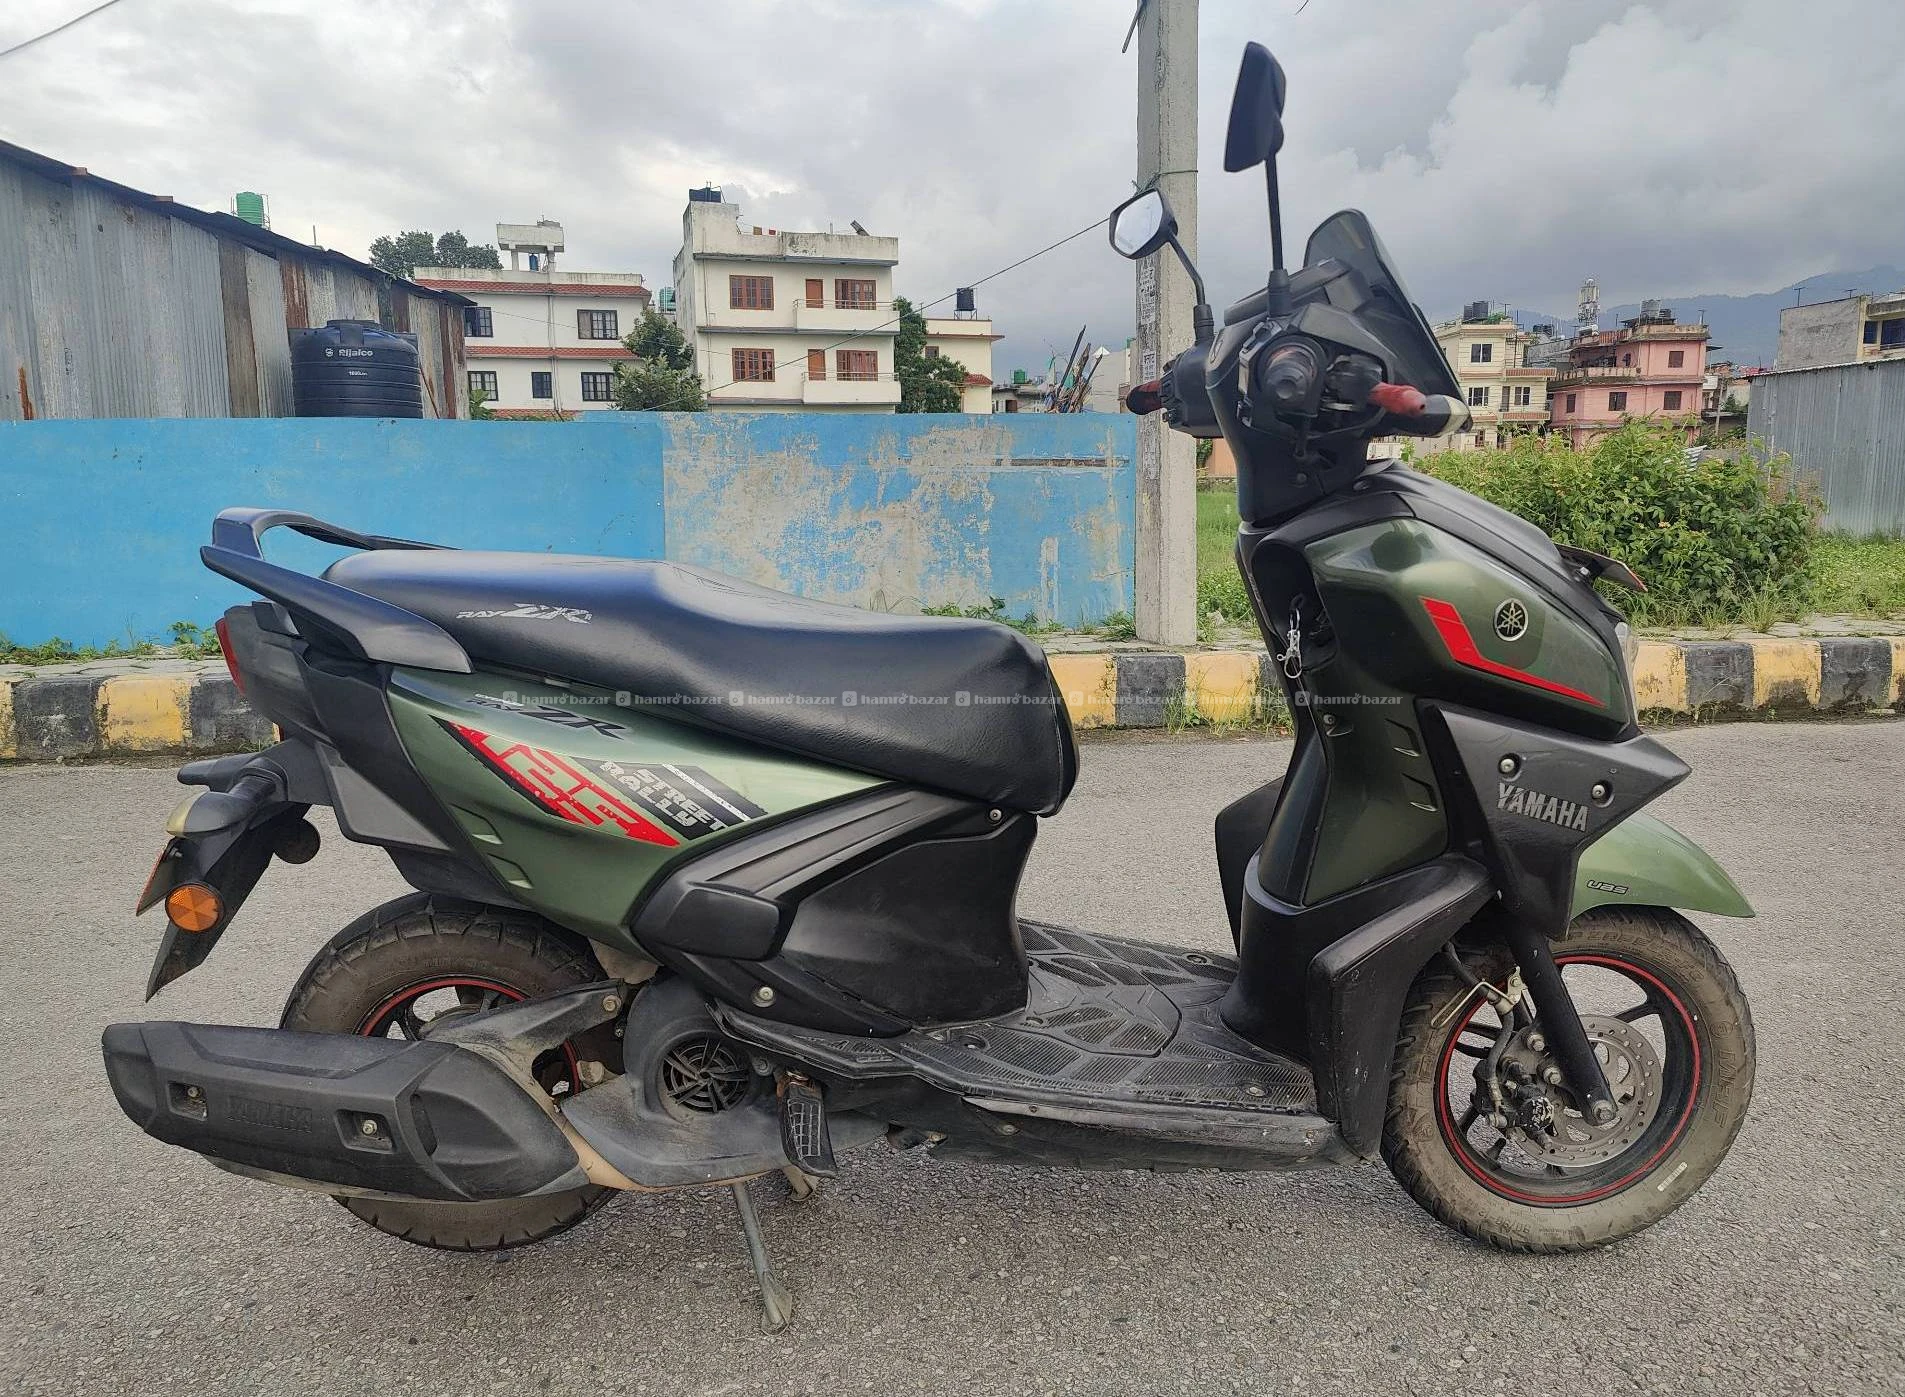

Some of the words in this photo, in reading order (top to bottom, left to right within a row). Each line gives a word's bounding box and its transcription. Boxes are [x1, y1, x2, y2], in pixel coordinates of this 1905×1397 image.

[599, 760, 699, 827] RALLY
[632, 768, 729, 831] STREET
[1497, 782, 1589, 832] YAMAHA
[1587, 879, 1629, 895] UBS
